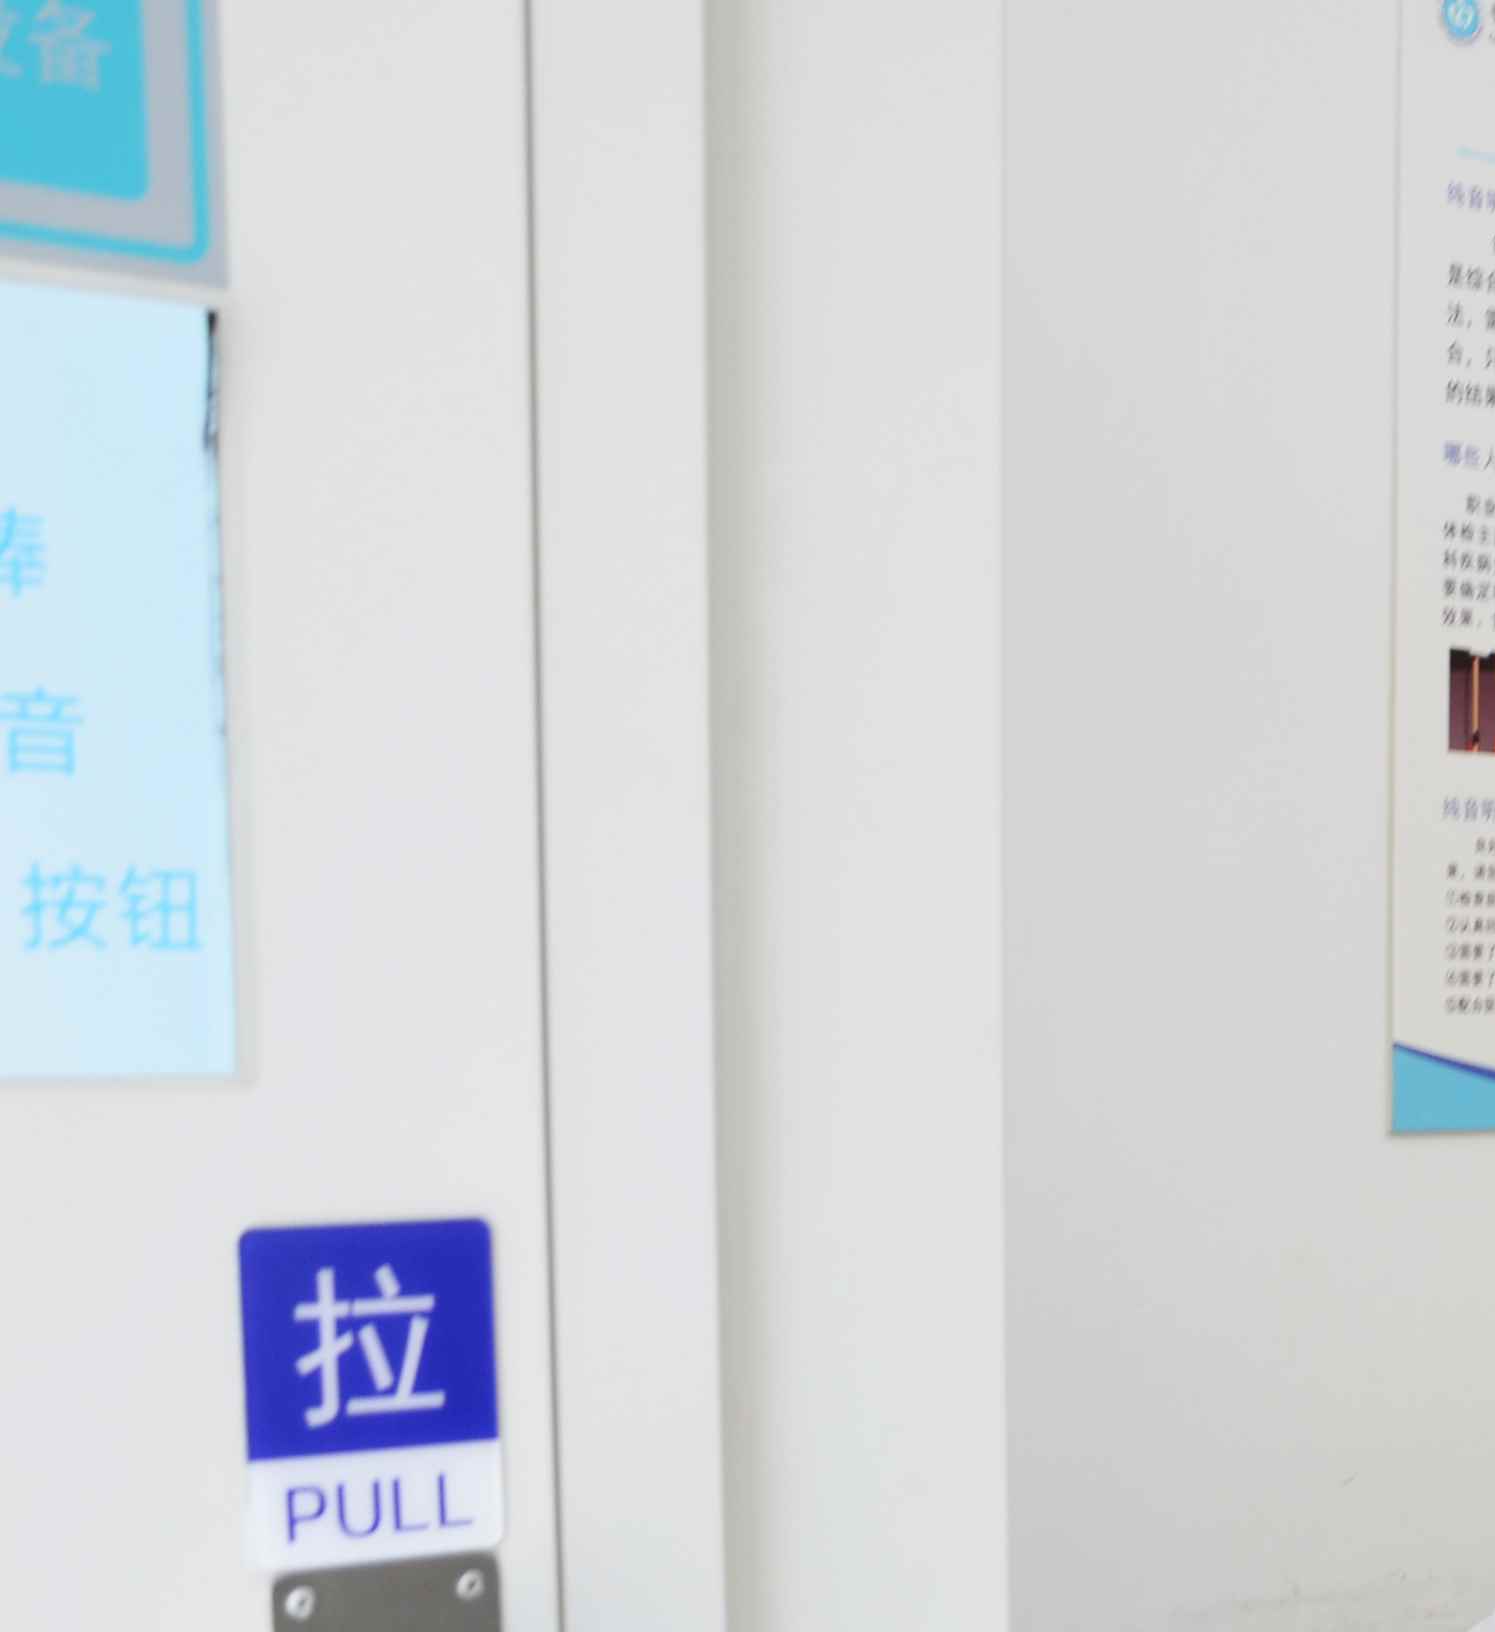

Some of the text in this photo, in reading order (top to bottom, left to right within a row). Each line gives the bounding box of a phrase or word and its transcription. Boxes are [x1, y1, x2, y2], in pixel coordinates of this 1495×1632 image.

[0, 0, 112, 94] 备
[20, 862, 205, 953] 按钮
[293, 1262, 446, 1430] 拉
[286, 1472, 475, 1545] PULL
